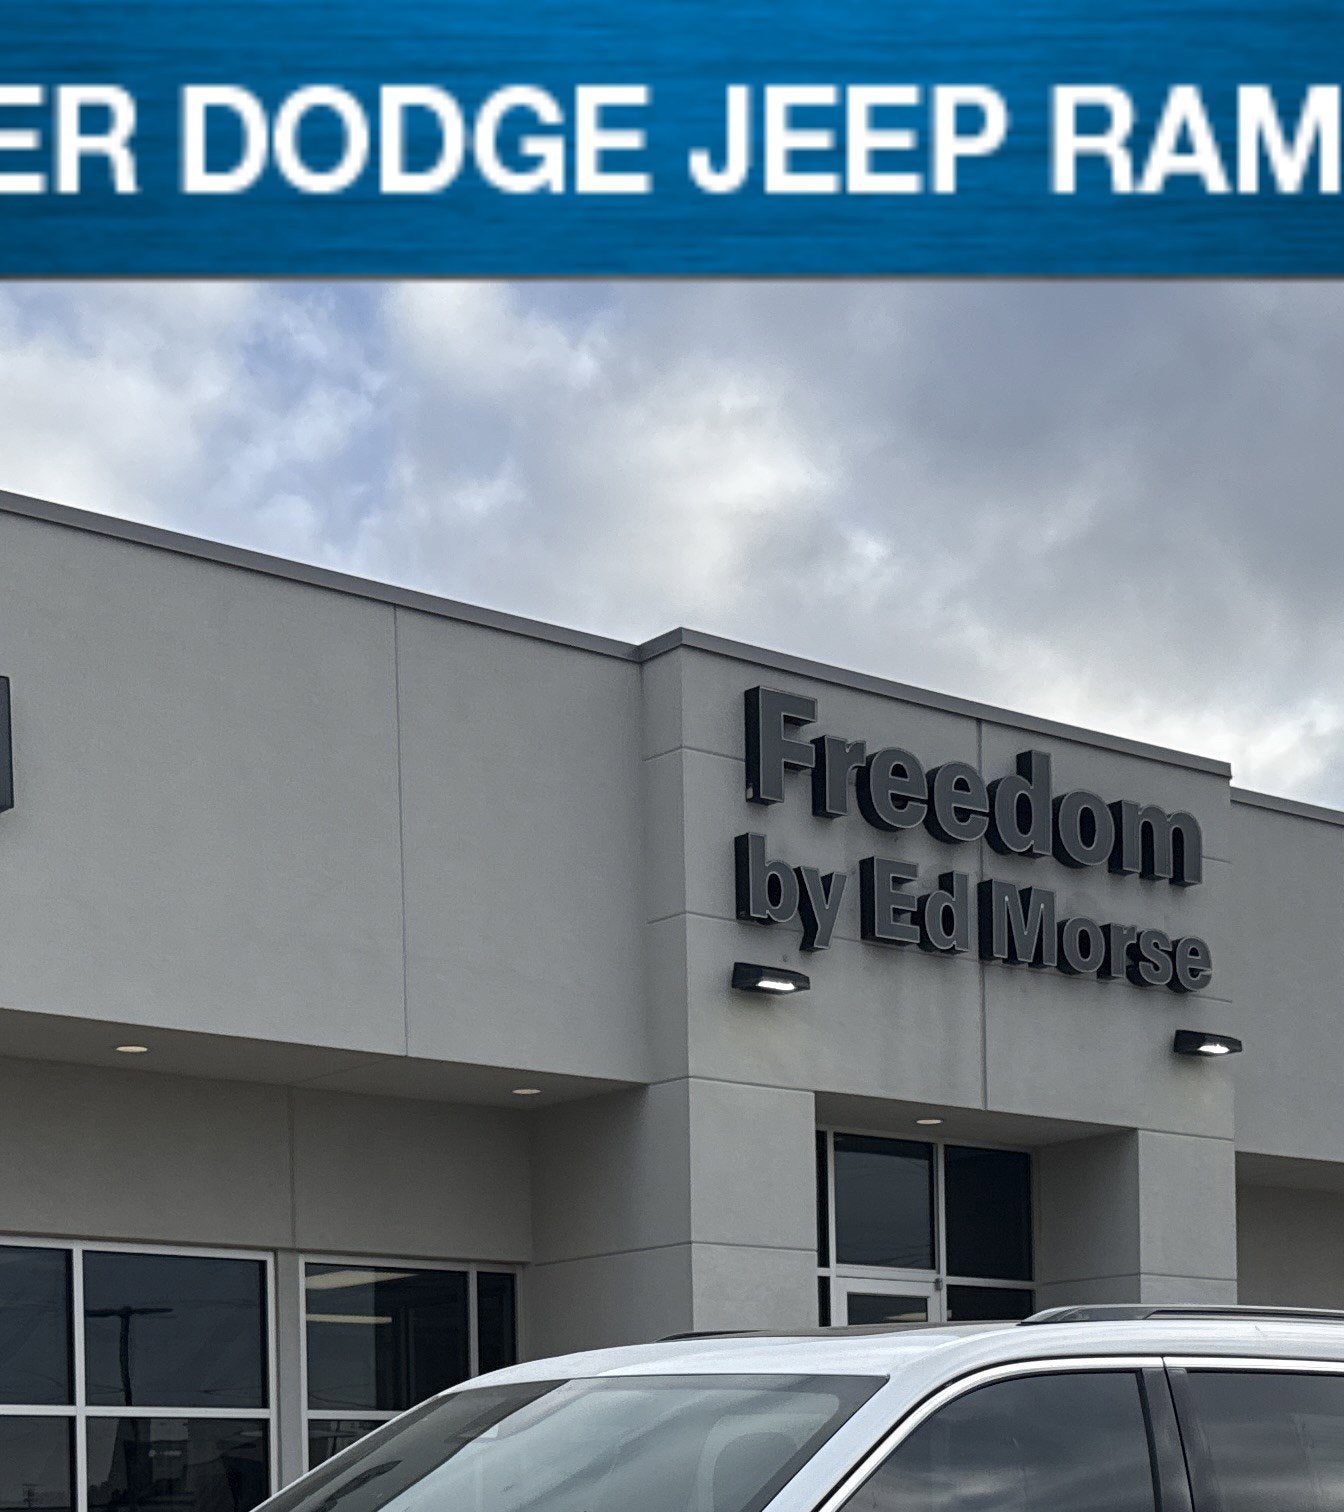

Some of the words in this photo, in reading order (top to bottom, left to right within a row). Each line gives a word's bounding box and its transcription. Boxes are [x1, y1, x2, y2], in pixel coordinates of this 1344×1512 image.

[744, 686, 1203, 886] Freedom
[734, 832, 847, 952] by
[860, 856, 969, 954] Ed
[978, 879, 1213, 993] Morse
